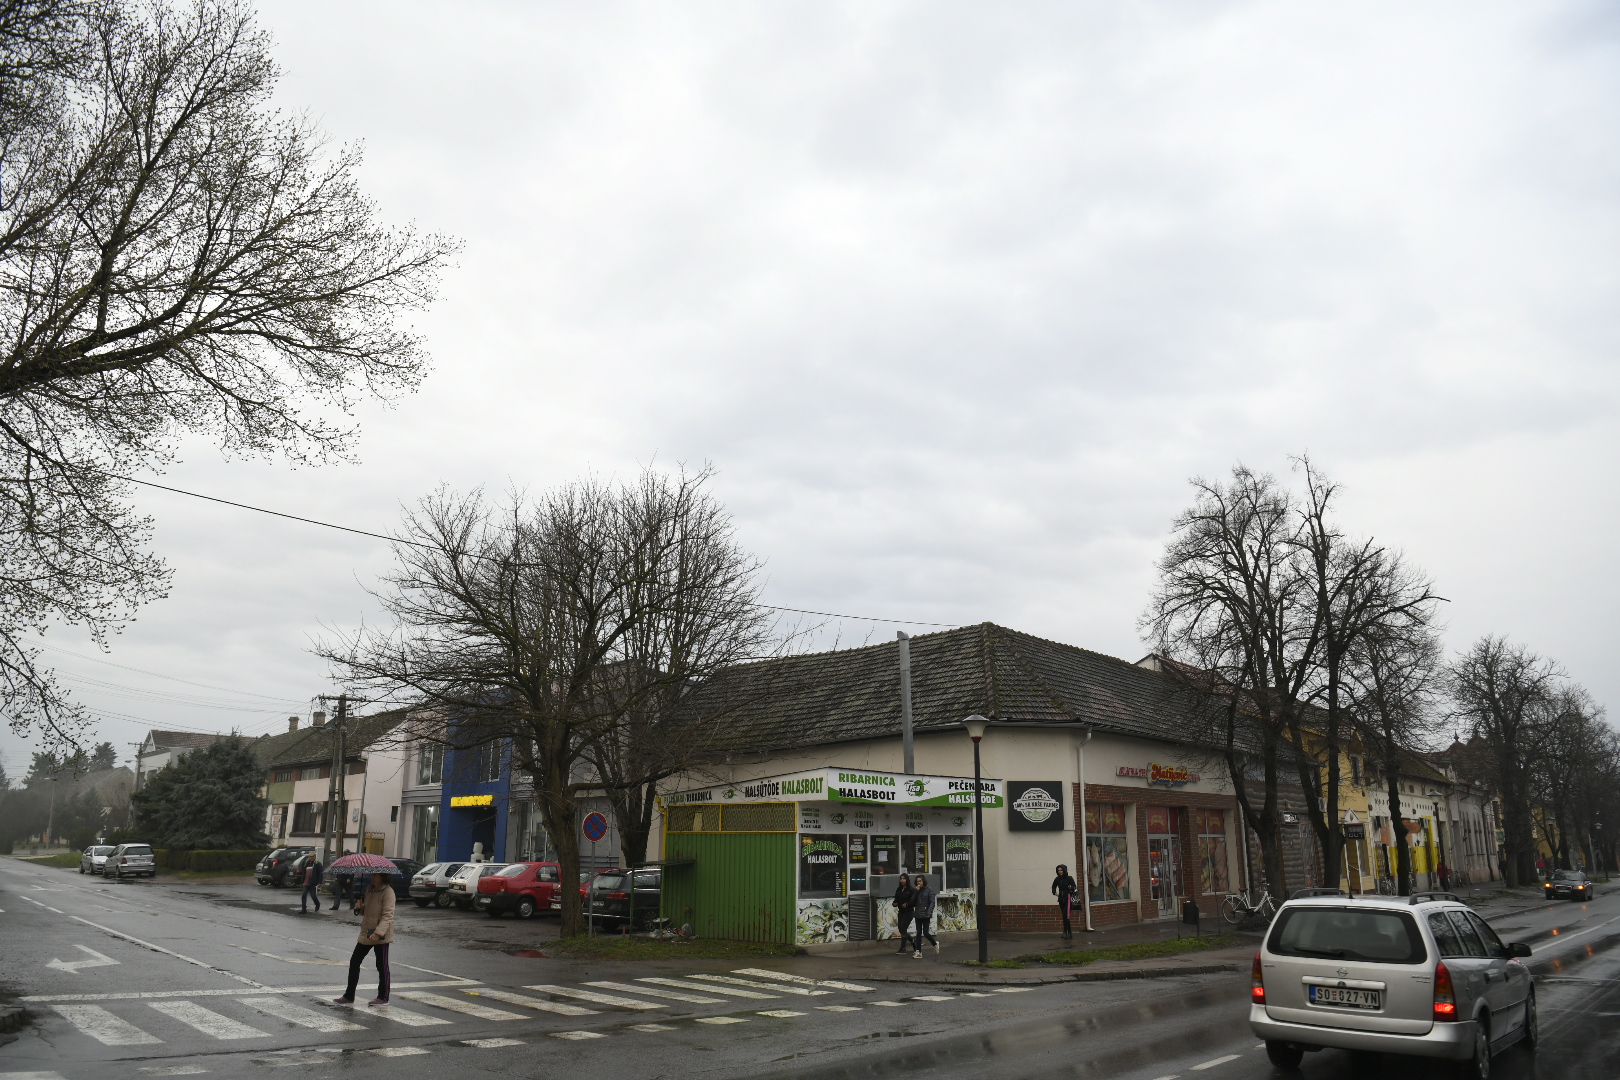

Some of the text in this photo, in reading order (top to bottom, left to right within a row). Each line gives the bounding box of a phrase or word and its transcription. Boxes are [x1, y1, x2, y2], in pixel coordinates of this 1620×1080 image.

[838, 772, 896, 786] RIBARNICA
[744, 781, 780, 798] HALSÜTÖDE
[781, 777, 824, 795] HALASBOLT
[948, 780, 996, 792] PEČENARA
[838, 787, 896, 801] HALASBOLT
[948, 792, 997, 804] HALSÜÖDE
[802, 840, 844, 858] RIBARNICA
[807, 855, 838, 864] HALASBOLT
[1317, 988, 1330, 1000] SO
